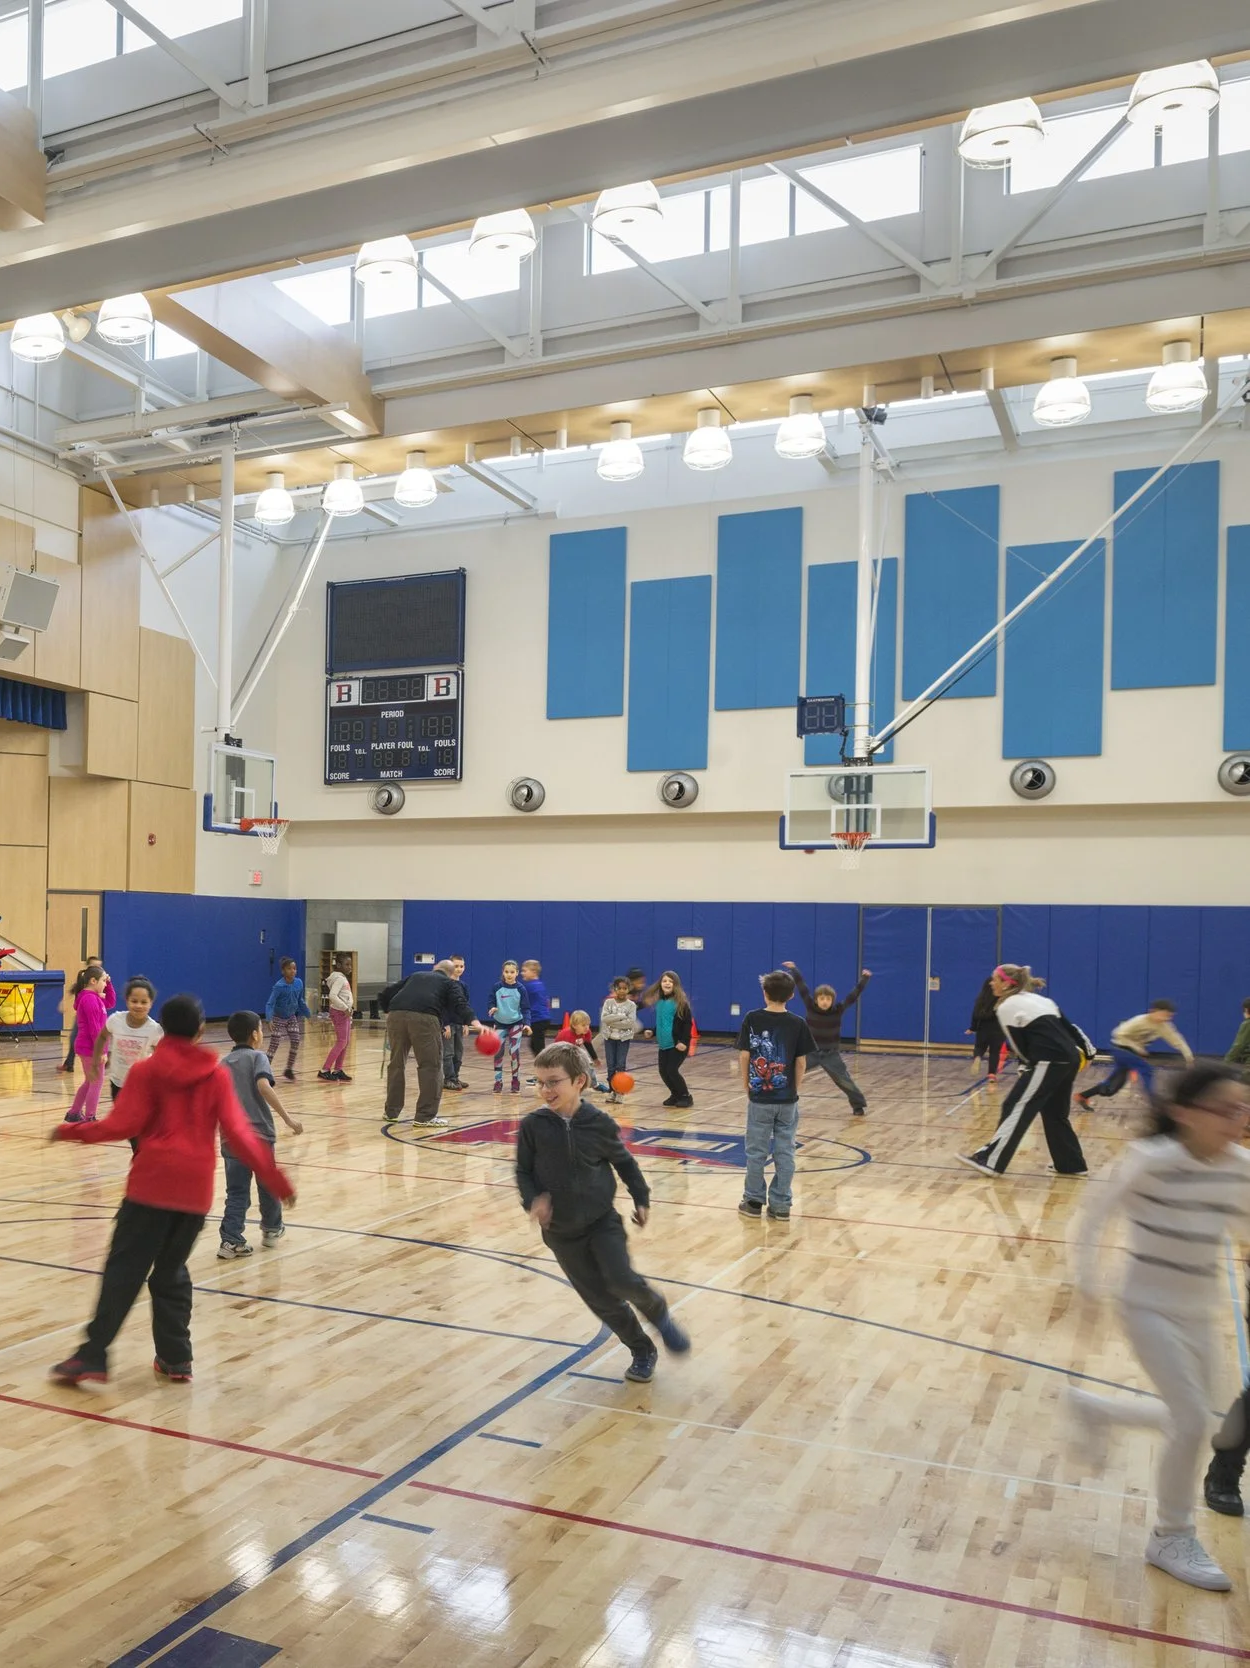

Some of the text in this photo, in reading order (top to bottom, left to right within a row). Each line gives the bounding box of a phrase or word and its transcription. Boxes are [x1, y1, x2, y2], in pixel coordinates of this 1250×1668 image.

[434, 677, 451, 697] B
[336, 684, 352, 703] B
[380, 710, 405, 719] PERIOD
[370, 741, 415, 750] PLAYER FOUL
[434, 739, 456, 747] FOULS
[330, 744, 351, 752] FOULS
[329, 772, 350, 780] SCORE
[380, 770, 403, 778] MATCH
[433, 768, 456, 776] SCORE
